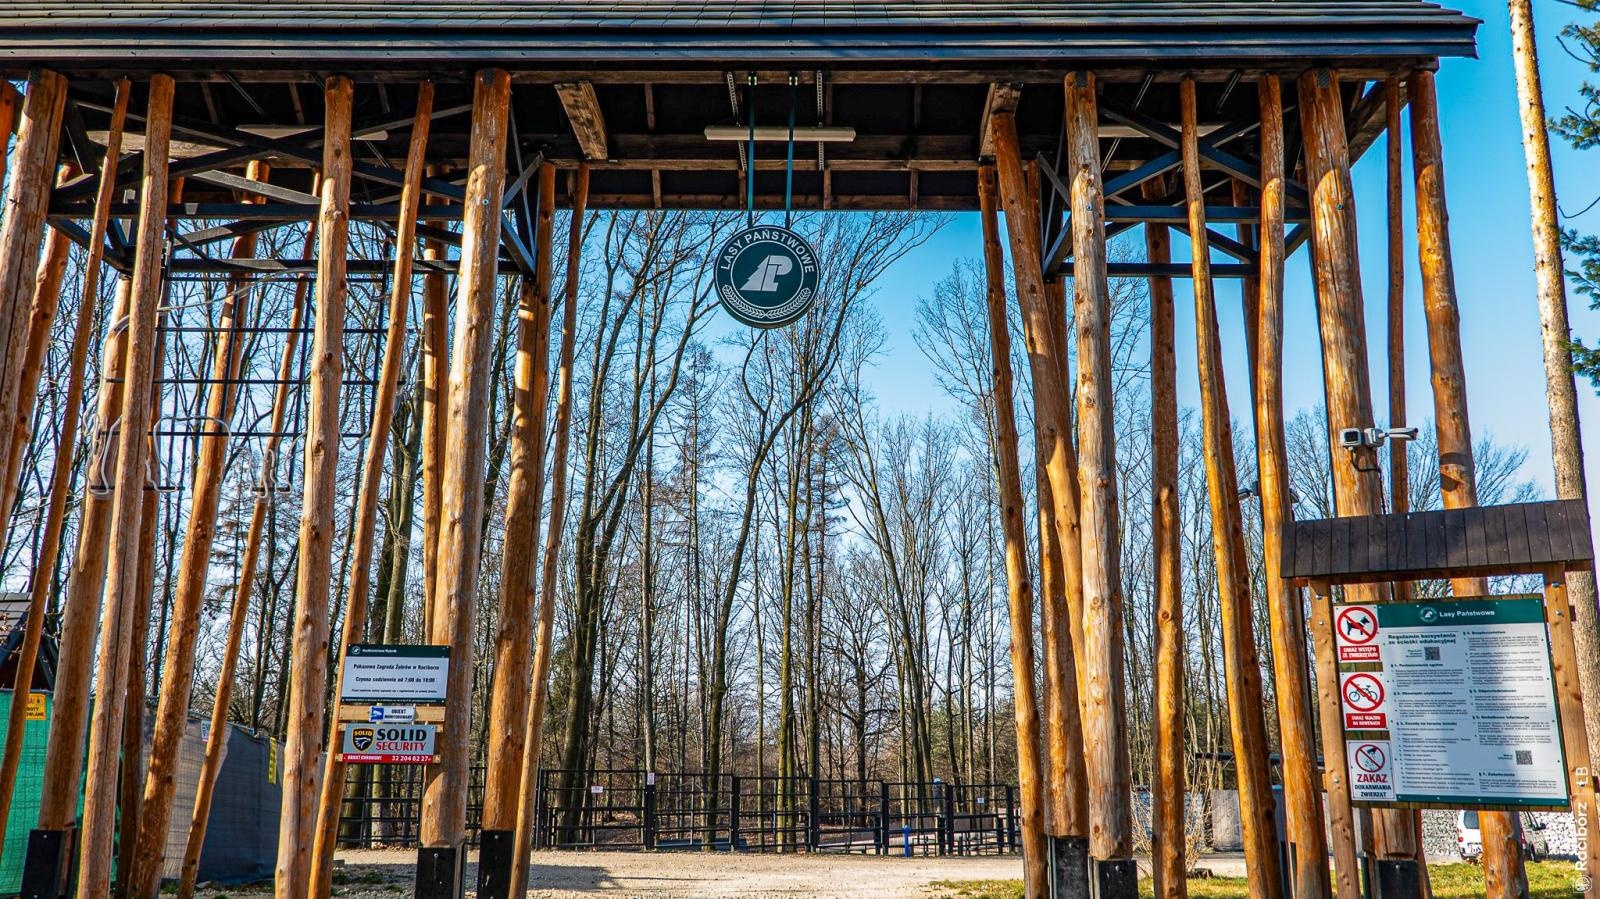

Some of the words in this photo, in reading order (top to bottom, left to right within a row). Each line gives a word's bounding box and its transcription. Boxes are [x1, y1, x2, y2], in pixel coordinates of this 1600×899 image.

[720, 240, 743, 270] LASY
[744, 229, 815, 273] PAŃSTWOWE
[1439, 610, 1455, 618] Lasy
[1456, 609, 1495, 617] Państwowe
[376, 728, 427, 742] SOLID
[376, 741, 427, 751] SECURITY
[1356, 773, 1388, 783] ZAKAZ
